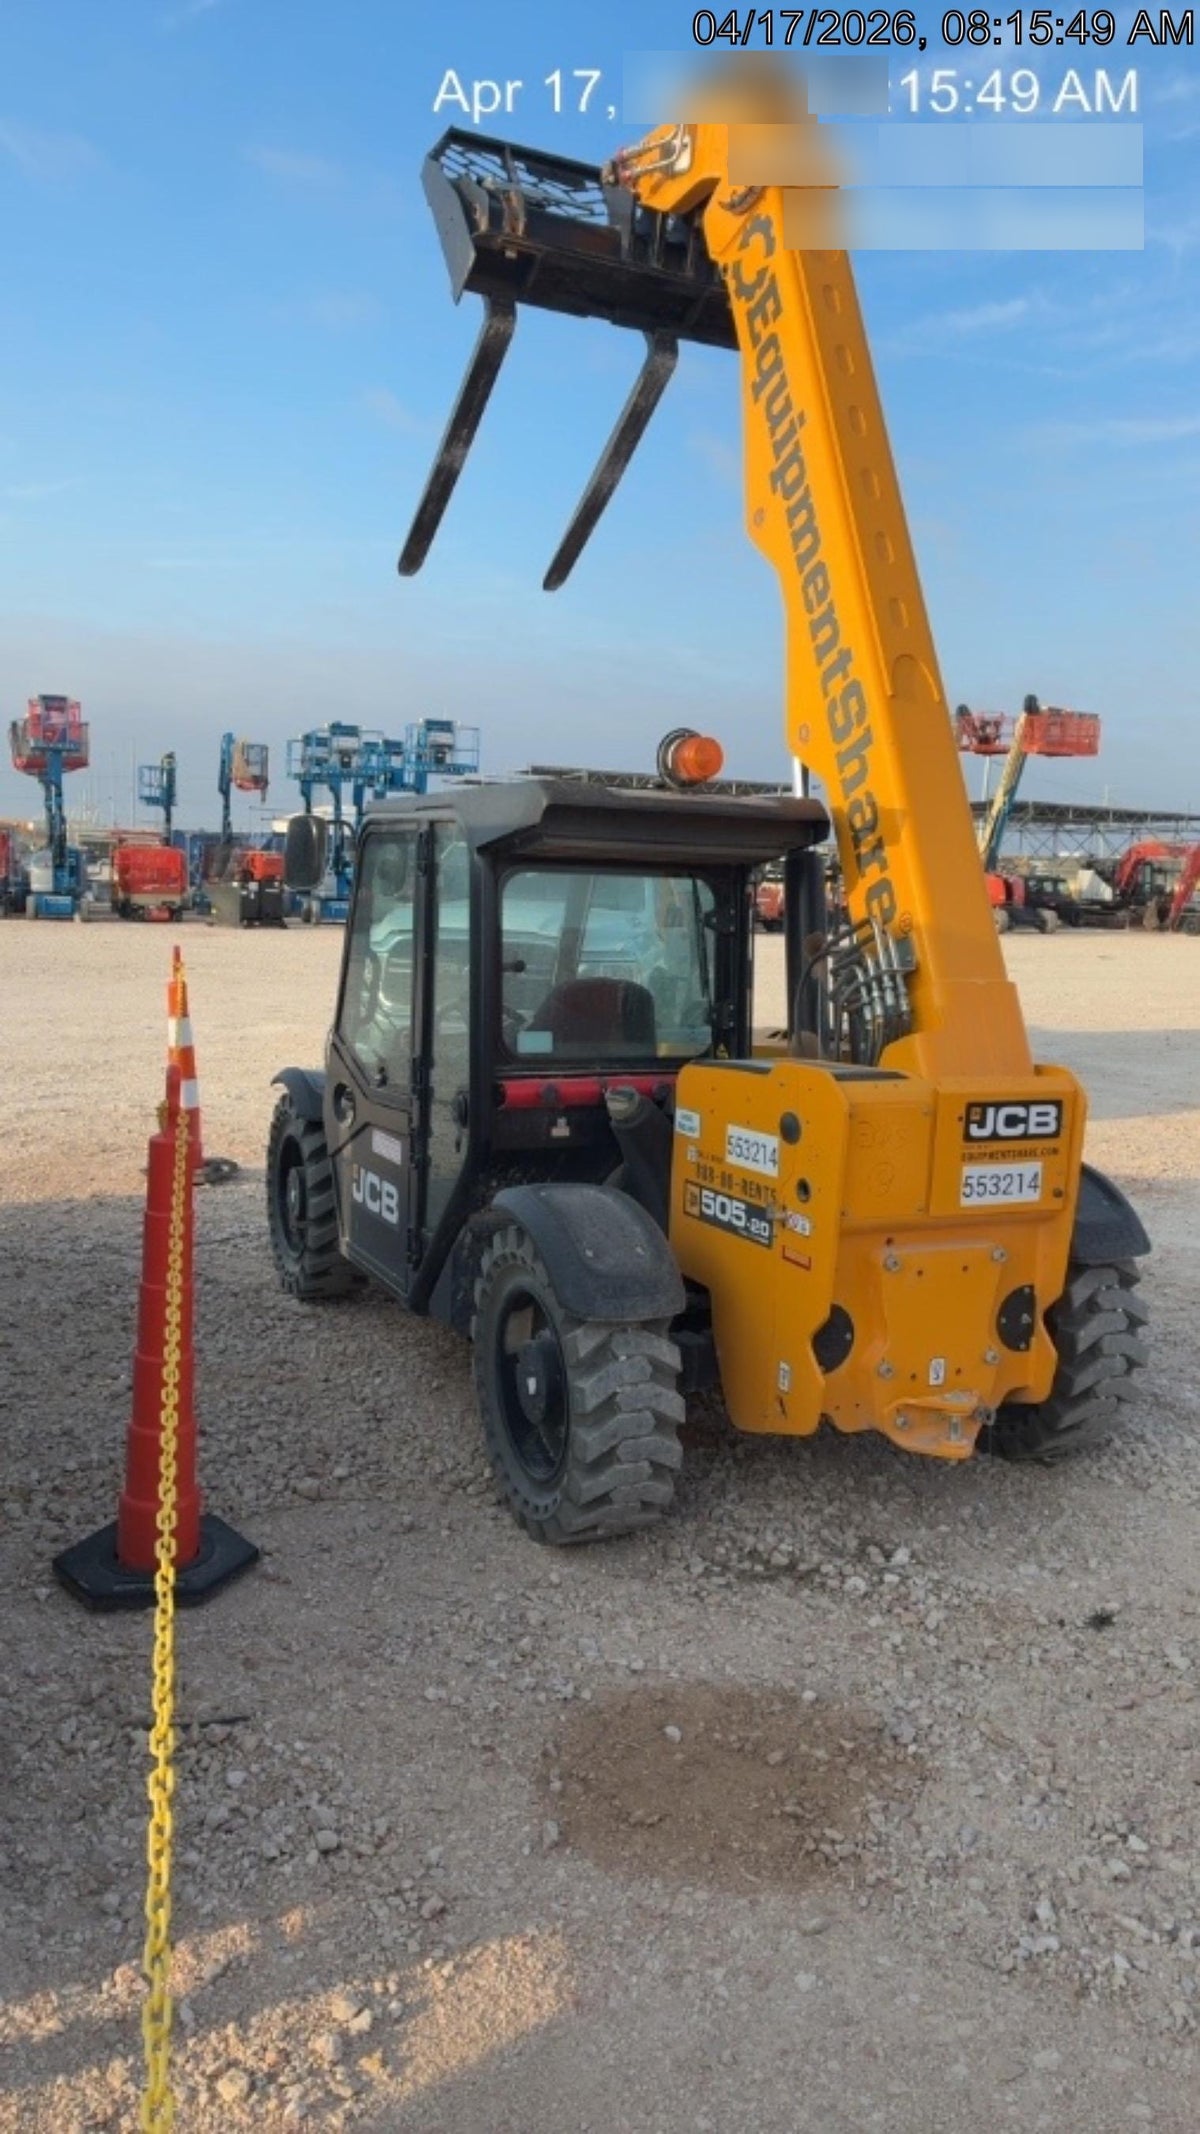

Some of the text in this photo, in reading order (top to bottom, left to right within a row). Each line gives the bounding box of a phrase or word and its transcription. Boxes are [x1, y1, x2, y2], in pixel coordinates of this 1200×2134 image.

[746, 271, 898, 926] EquipmentShare
[968, 1103, 1059, 1138] JCB
[727, 1135, 778, 1168] 553214
[351, 1166, 400, 1225] JCB
[962, 1172, 1040, 1199] 553214
